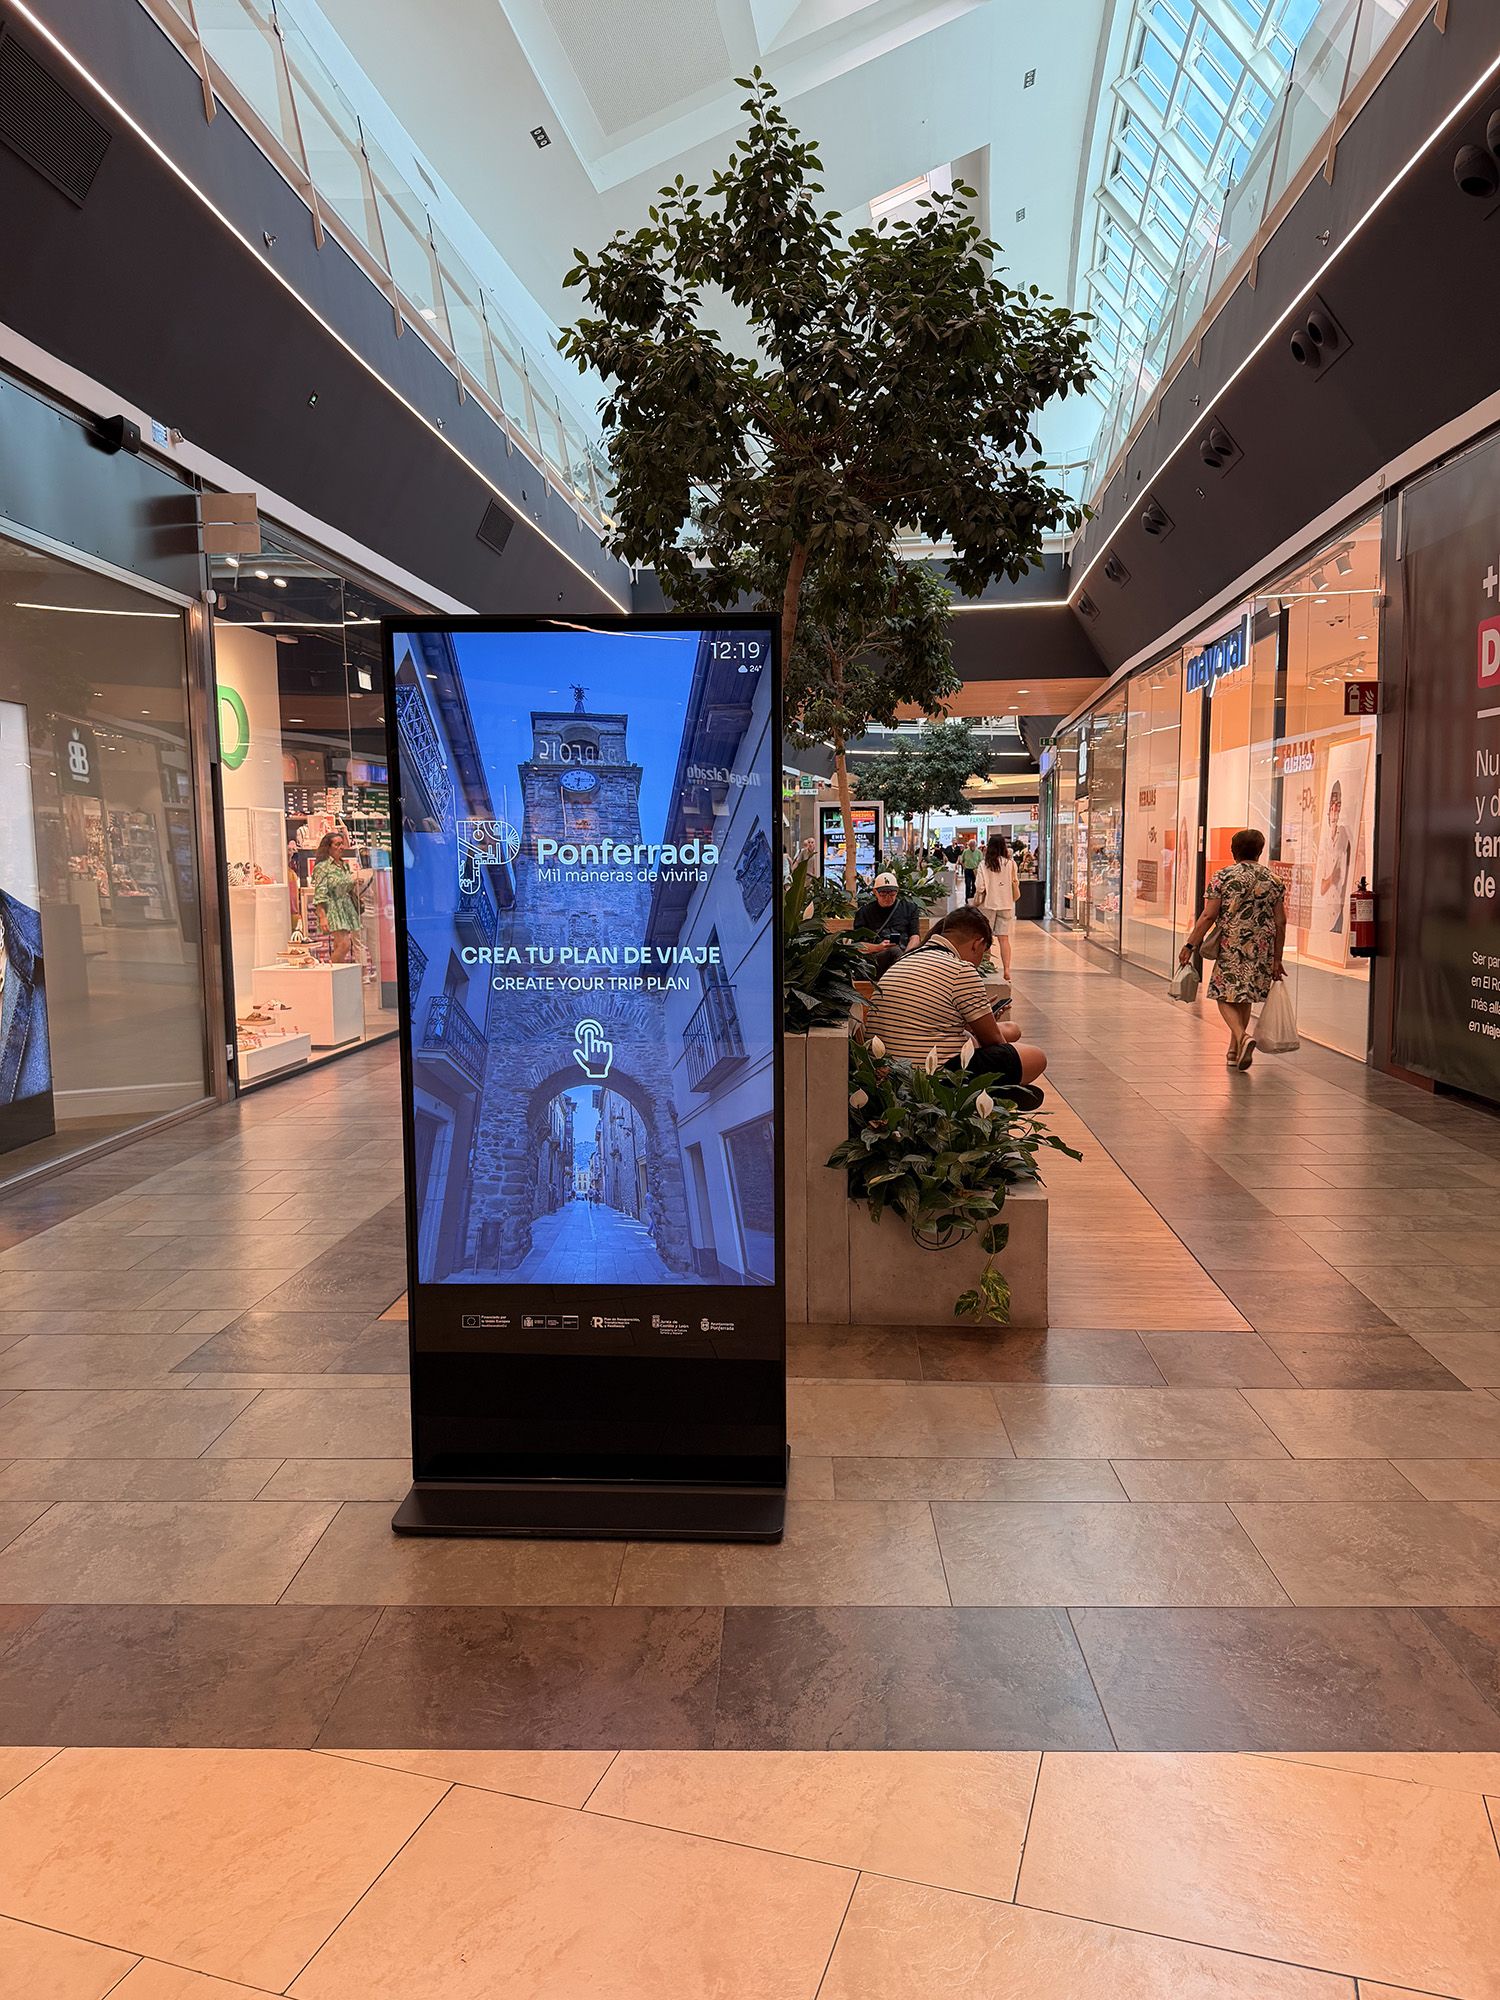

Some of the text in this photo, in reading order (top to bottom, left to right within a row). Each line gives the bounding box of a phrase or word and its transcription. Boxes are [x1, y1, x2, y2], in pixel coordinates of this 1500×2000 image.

[711, 641, 760, 659] 12:19
[1186, 613, 1250, 698] mayoral
[1475, 794, 1486, 824] y
[537, 838, 719, 865] Ponferrada
[538, 868, 708, 883] Mil maneras de vivirla
[1474, 870, 1496, 898] de
[461, 946, 720, 965] CREA TU PLAN DE VIAJE
[1472, 951, 1487, 966] Ser
[492, 977, 690, 990] CREATE YOUR TRIP PLAN
[1471, 976, 1482, 988] en
[1471, 997, 1488, 1012] más
[1468, 1020, 1481, 1033] en
